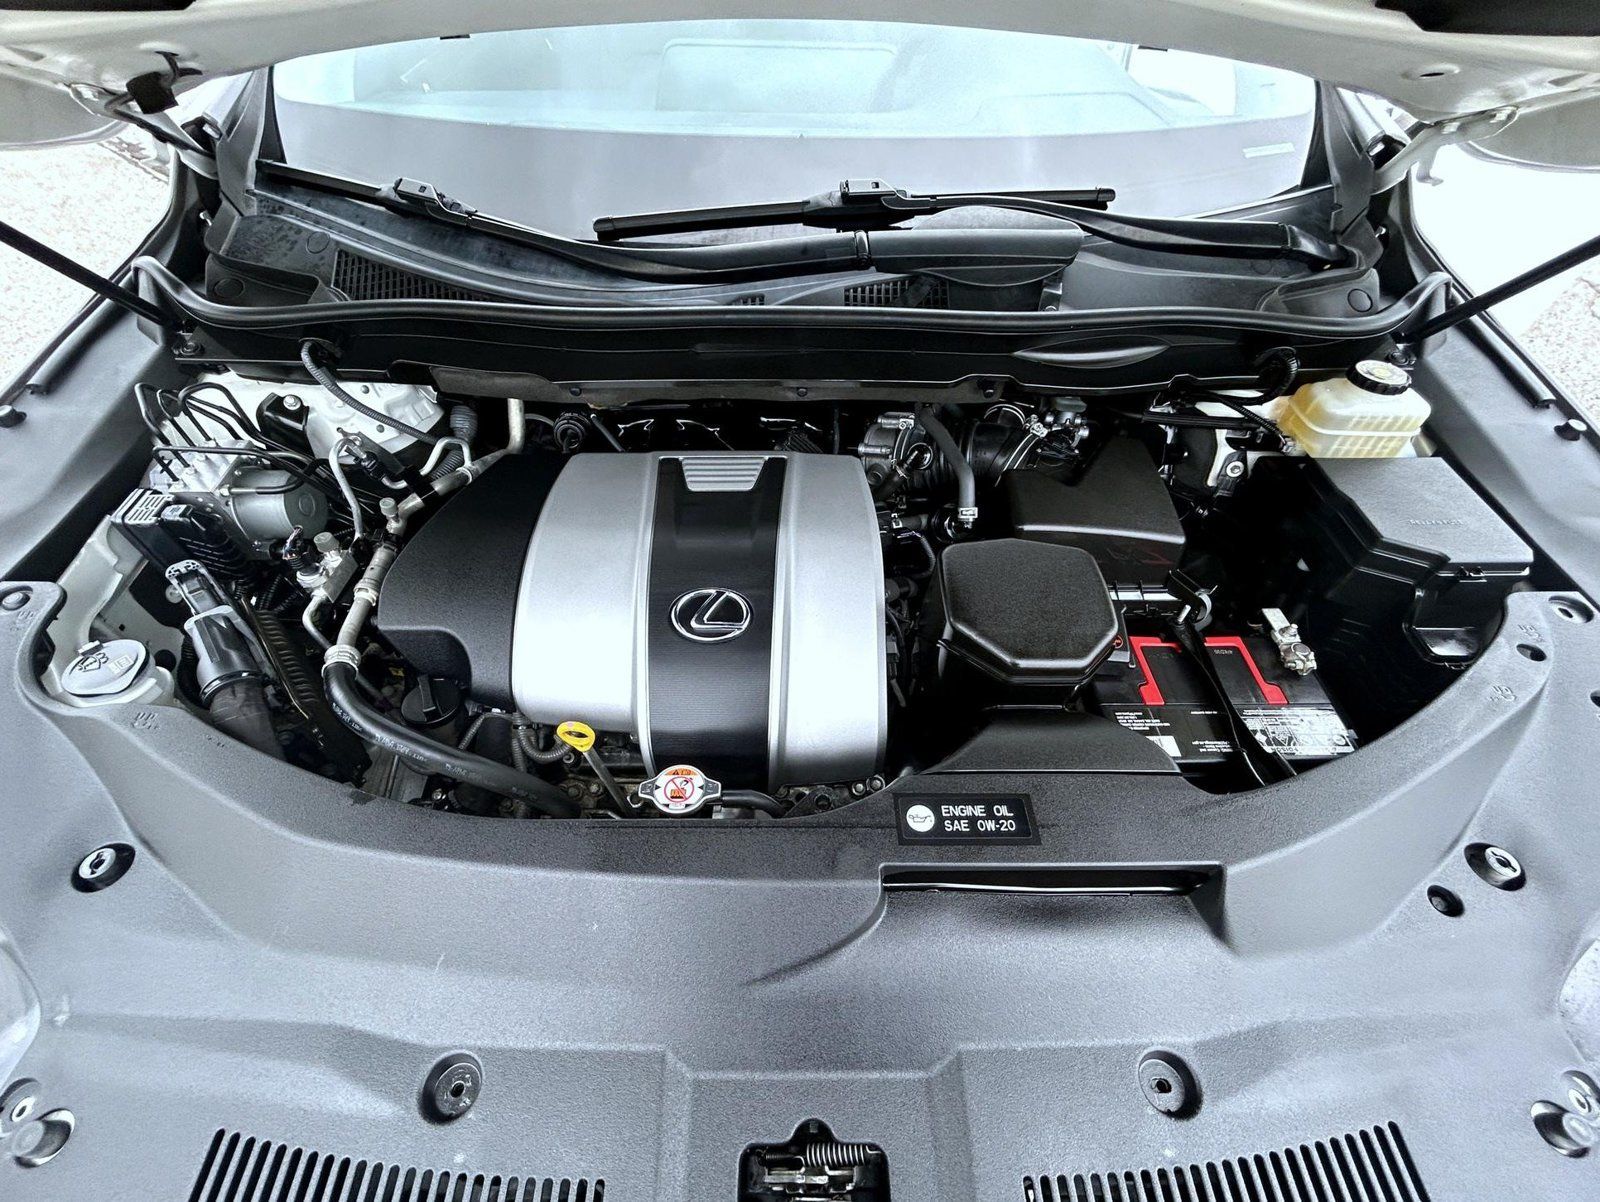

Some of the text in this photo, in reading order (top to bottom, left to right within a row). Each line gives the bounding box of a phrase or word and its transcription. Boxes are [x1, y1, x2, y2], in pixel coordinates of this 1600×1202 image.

[941, 805, 1014, 817] ENGINE OIL
[944, 820, 1016, 832] SAE 0W-20
